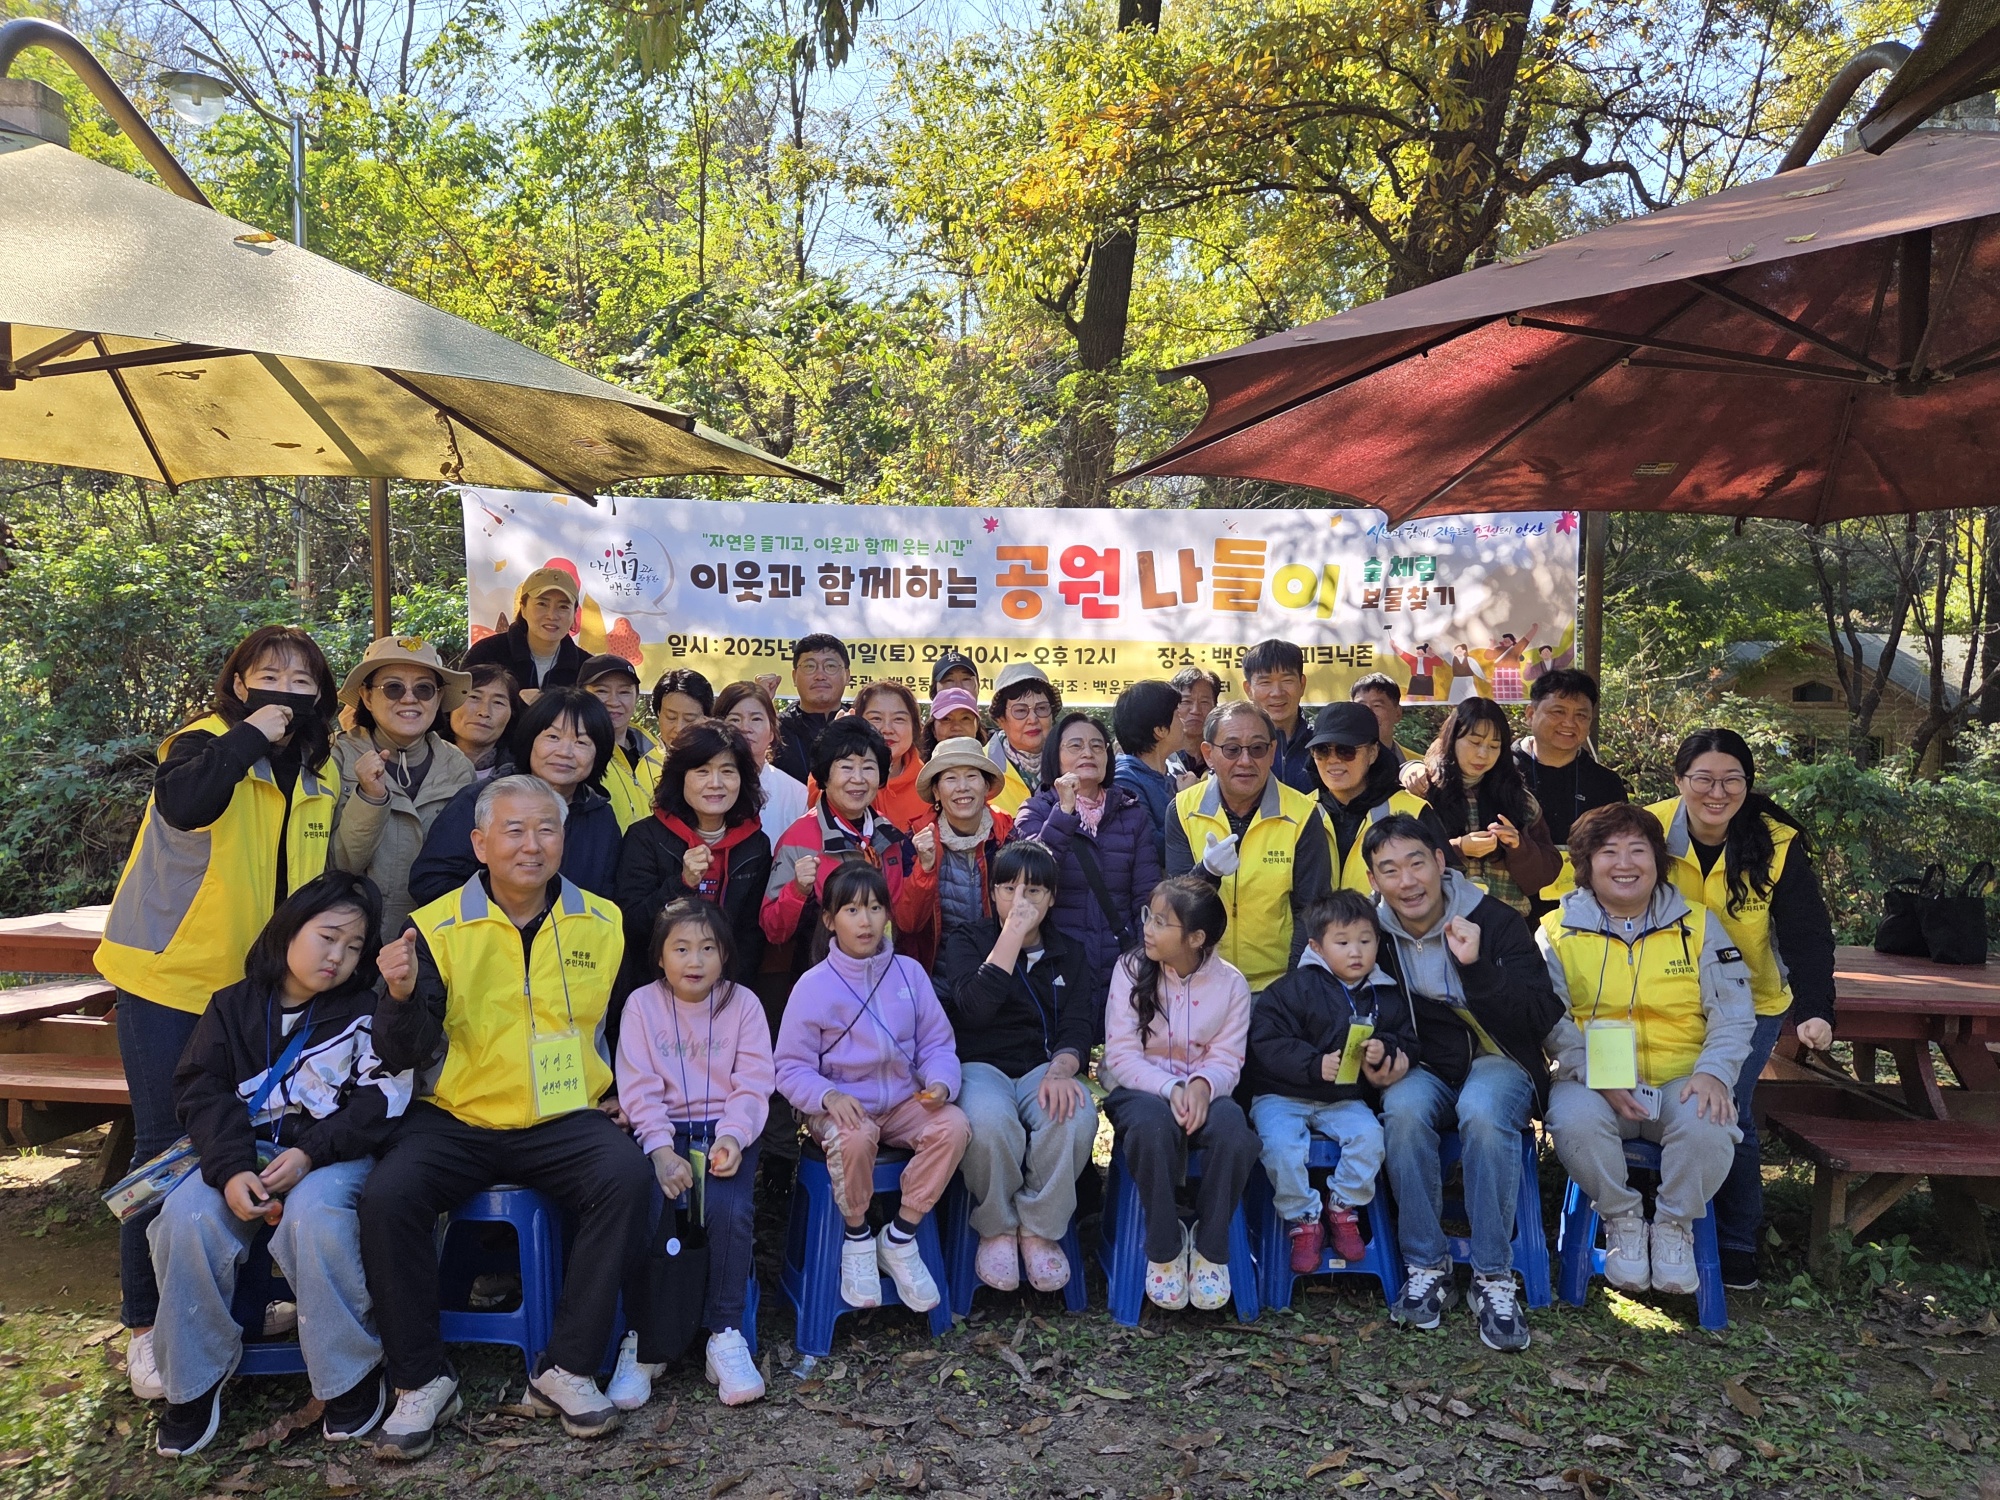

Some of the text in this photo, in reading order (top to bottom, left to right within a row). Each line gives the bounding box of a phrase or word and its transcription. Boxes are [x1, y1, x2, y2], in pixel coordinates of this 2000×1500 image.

[1515, 522, 1548, 537] 안산
[702, 533, 973, 557] "자연을 즐기고, 이웃과 함께 웃는 시간"
[1389, 554, 1437, 582] 체험
[609, 581, 643, 597] 백운동
[689, 560, 806, 603] 이웃과
[817, 562, 978, 609] 함께하는
[1361, 585, 1456, 613] 보물찾기
[723, 637, 795, 661] 2025년
[963, 646, 1009, 664] 10시
[1033, 645, 1068, 667] 오후
[1074, 647, 1116, 665] 12시
[564, 958, 597, 970] 주민자치회
[571, 950, 591, 960] 백운동
